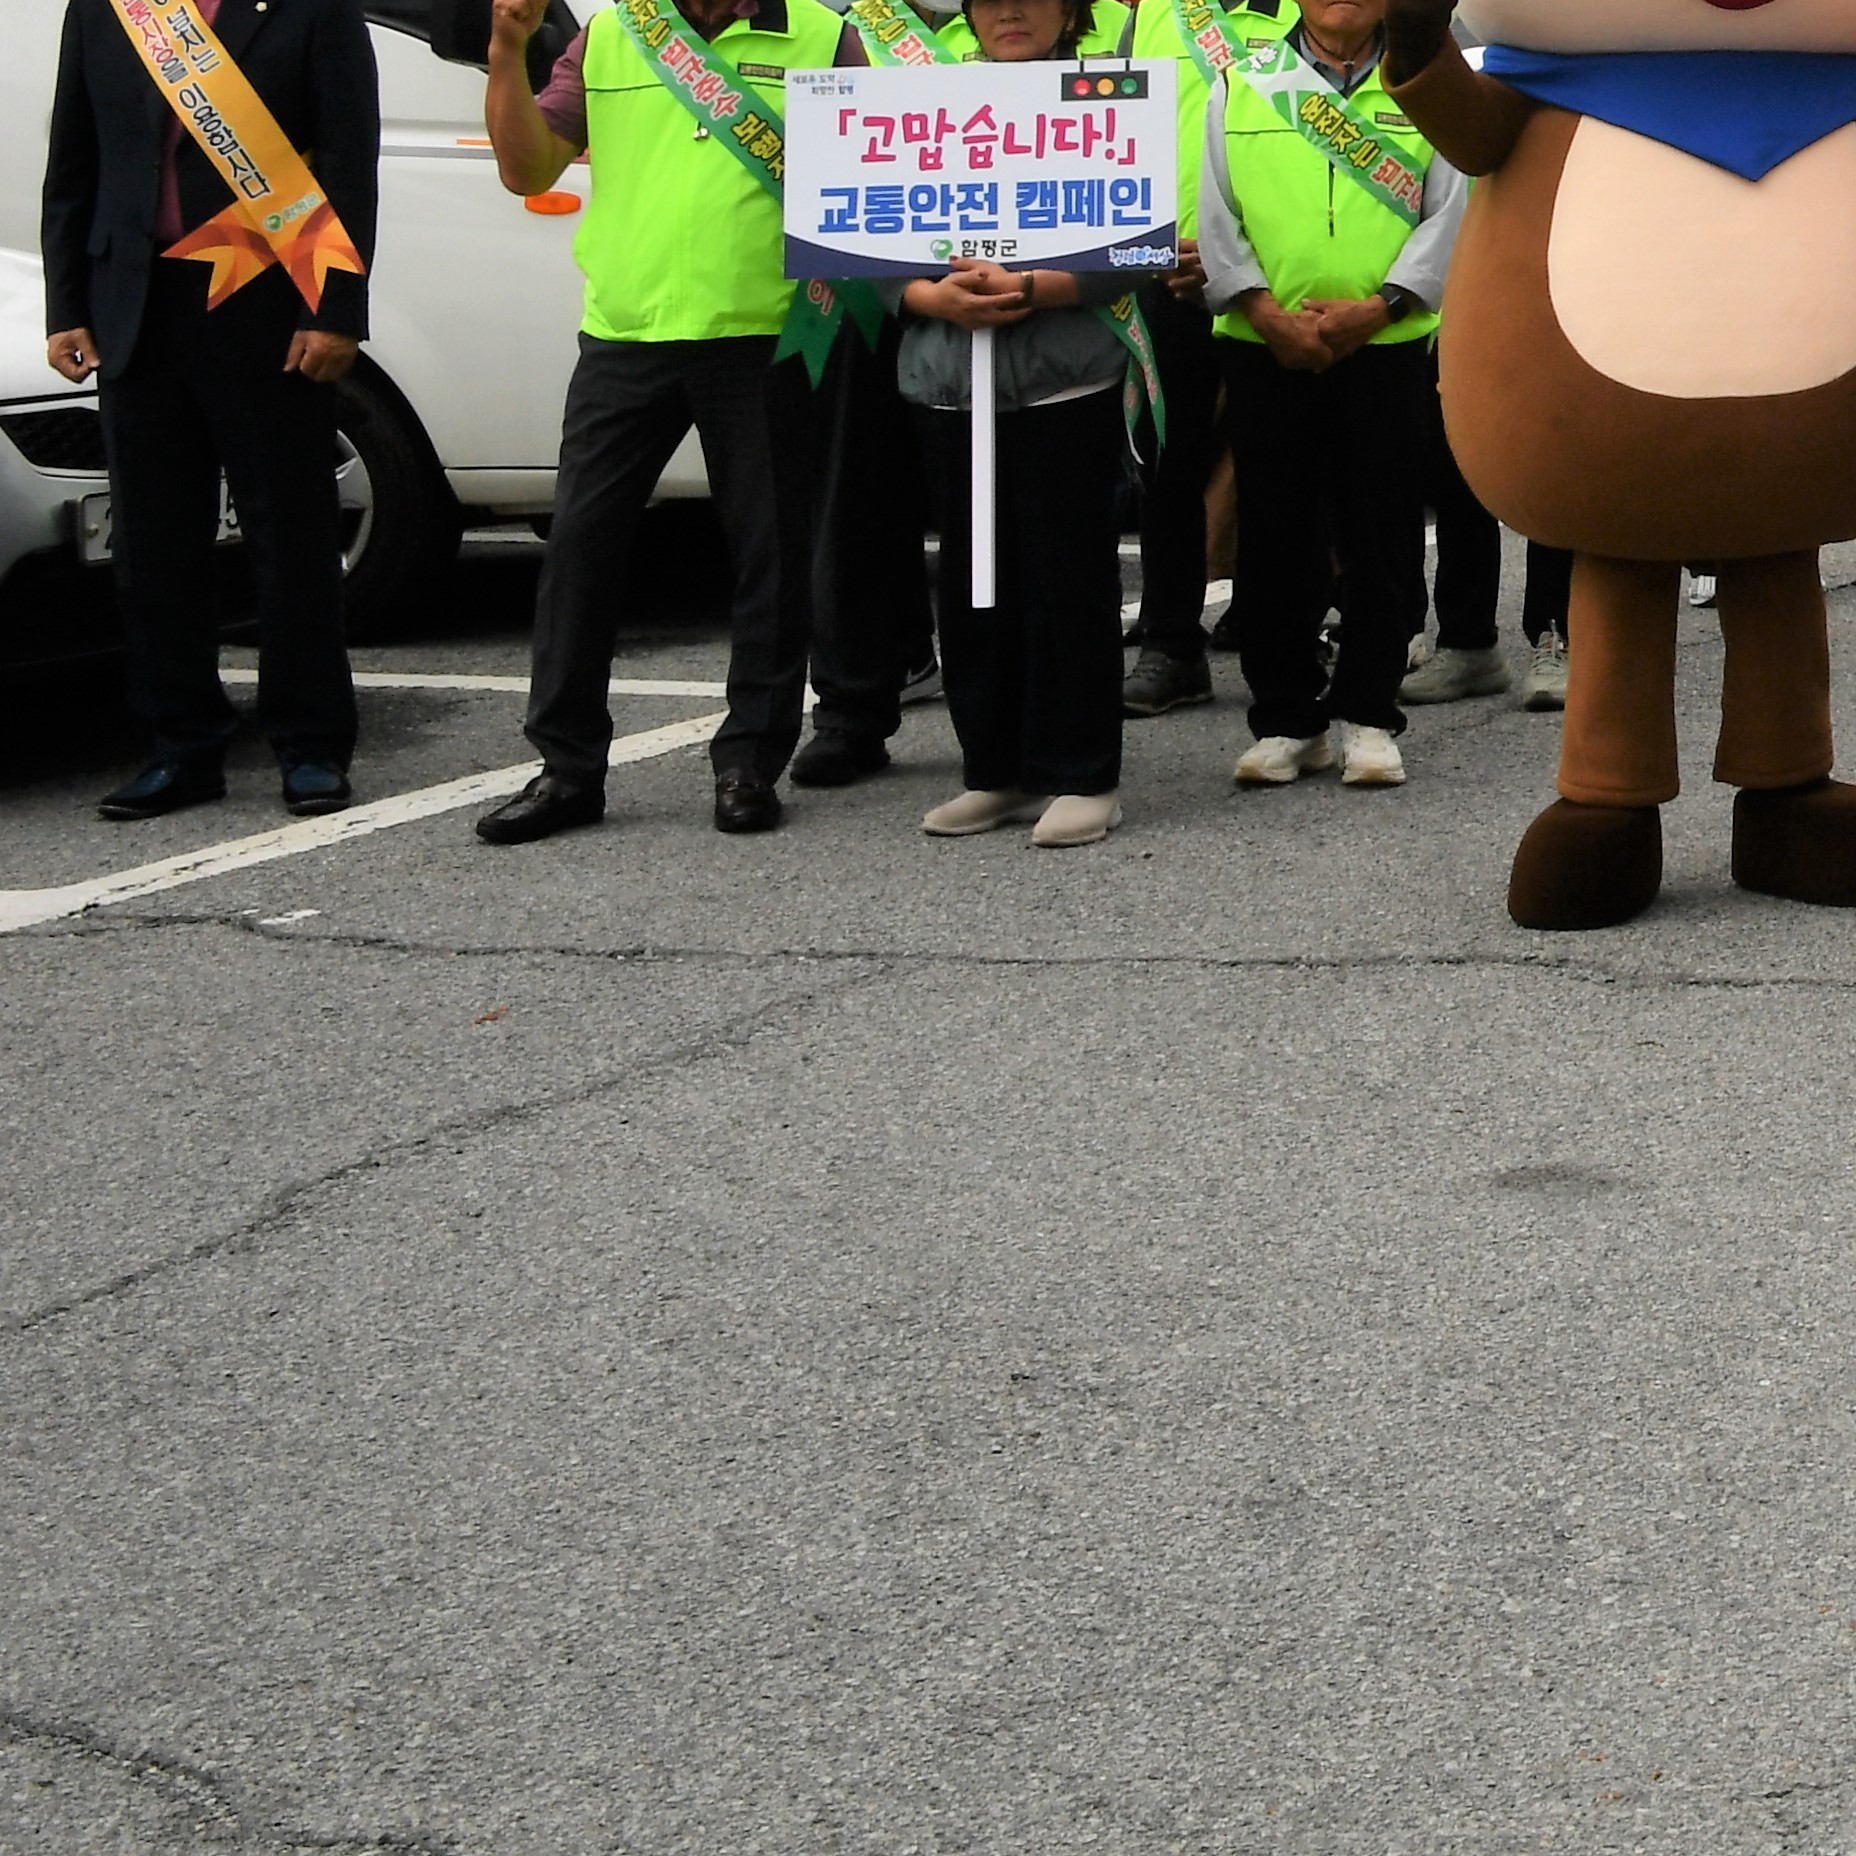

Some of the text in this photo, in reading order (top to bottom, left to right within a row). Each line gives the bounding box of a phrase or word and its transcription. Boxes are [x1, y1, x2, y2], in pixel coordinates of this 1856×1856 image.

[658, 35, 742, 119] 법규준수
[1195, 23, 1236, 73] 법규
[178, 81, 272, 199] 이용합시다
[1299, 93, 1381, 169] 운전자는
[817, 177, 1152, 234] 교통안전 캠페인
[960, 238, 1018, 259] 함평군
